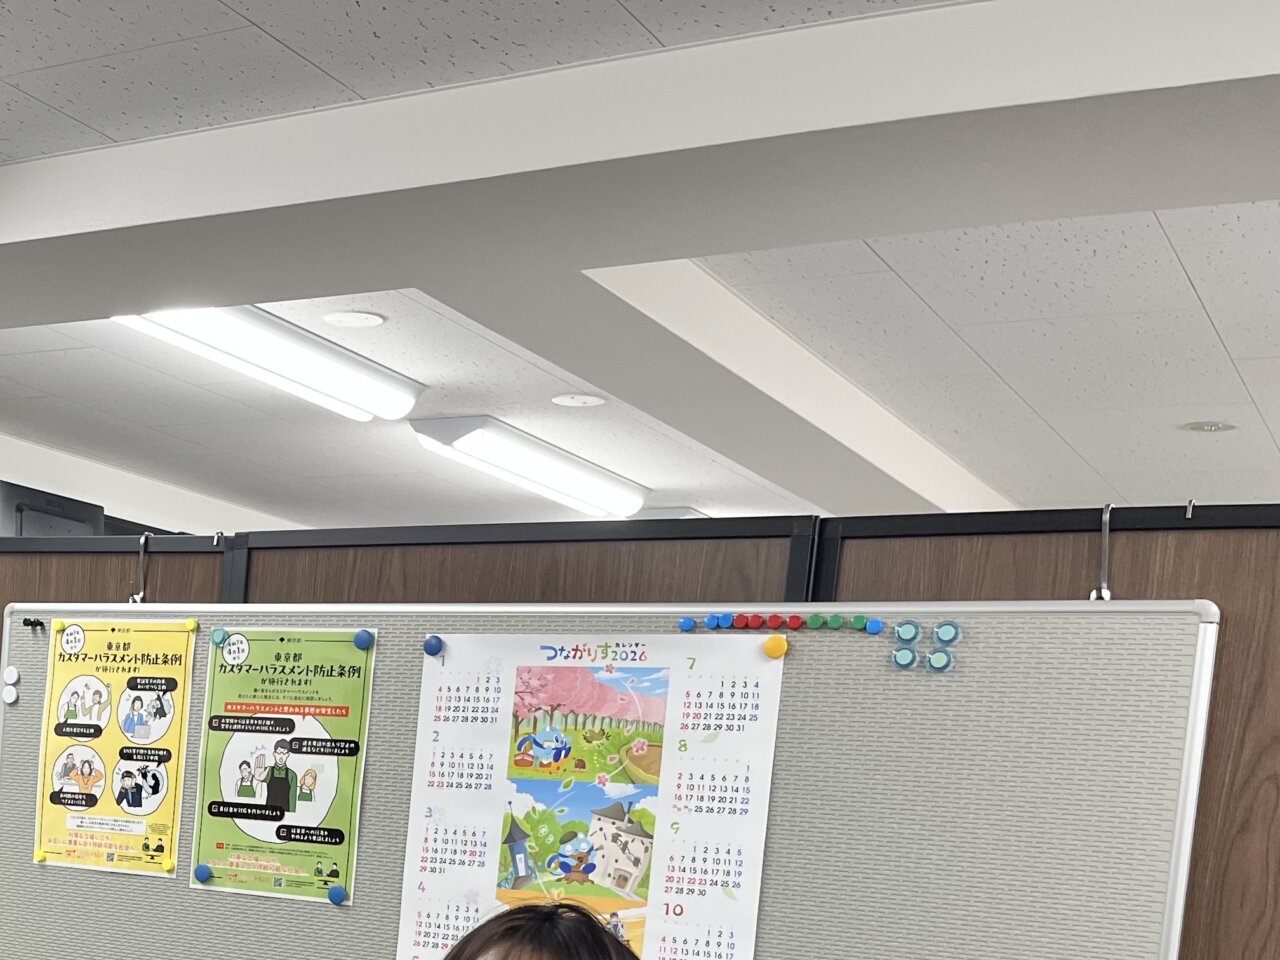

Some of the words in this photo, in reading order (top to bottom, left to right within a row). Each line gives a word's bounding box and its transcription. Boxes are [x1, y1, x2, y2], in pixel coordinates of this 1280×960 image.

[107, 642, 131, 651] 東京都
[58, 653, 182, 666] カスタマーハラスメント防止条例
[274, 652, 303, 662] 東京都
[439, 656, 445, 666] 1
[687, 657, 696, 670] 7
[219, 664, 361, 679] カスタマーハラスメント防止条例
[432, 731, 440, 742] 2
[678, 740, 688, 752] 8
[425, 807, 432, 818] 3
[670, 822, 680, 834] 9
[418, 881, 425, 893] 4
[664, 903, 684, 916] 10
